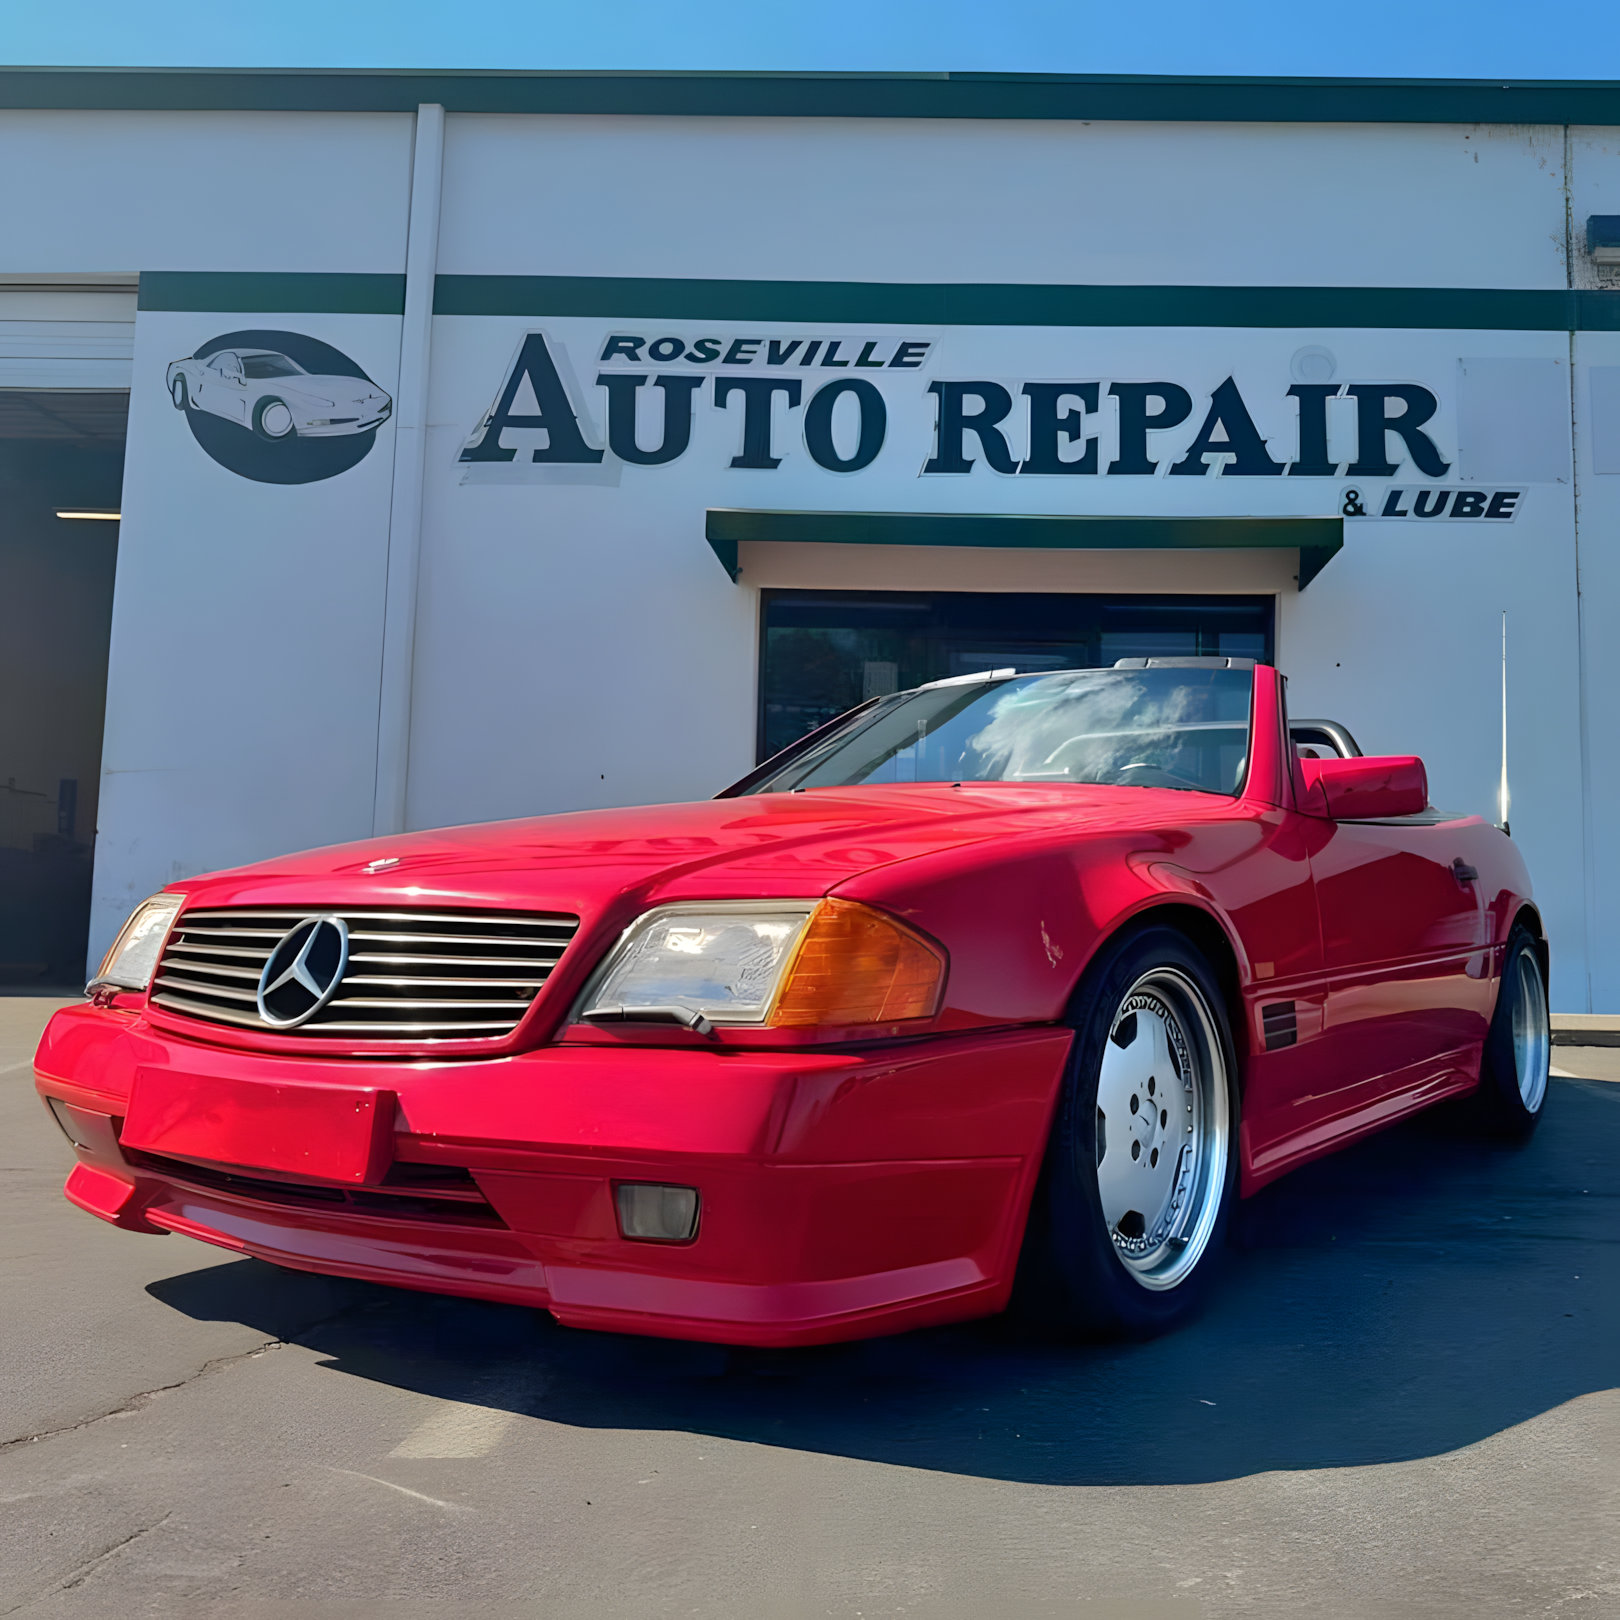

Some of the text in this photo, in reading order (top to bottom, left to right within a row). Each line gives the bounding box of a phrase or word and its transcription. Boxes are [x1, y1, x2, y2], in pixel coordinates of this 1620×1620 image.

[600, 335, 931, 368] ROSEVILLE
[459, 333, 1452, 478] AUTO REPAIR
[1342, 489, 1521, 519] & LUBE
